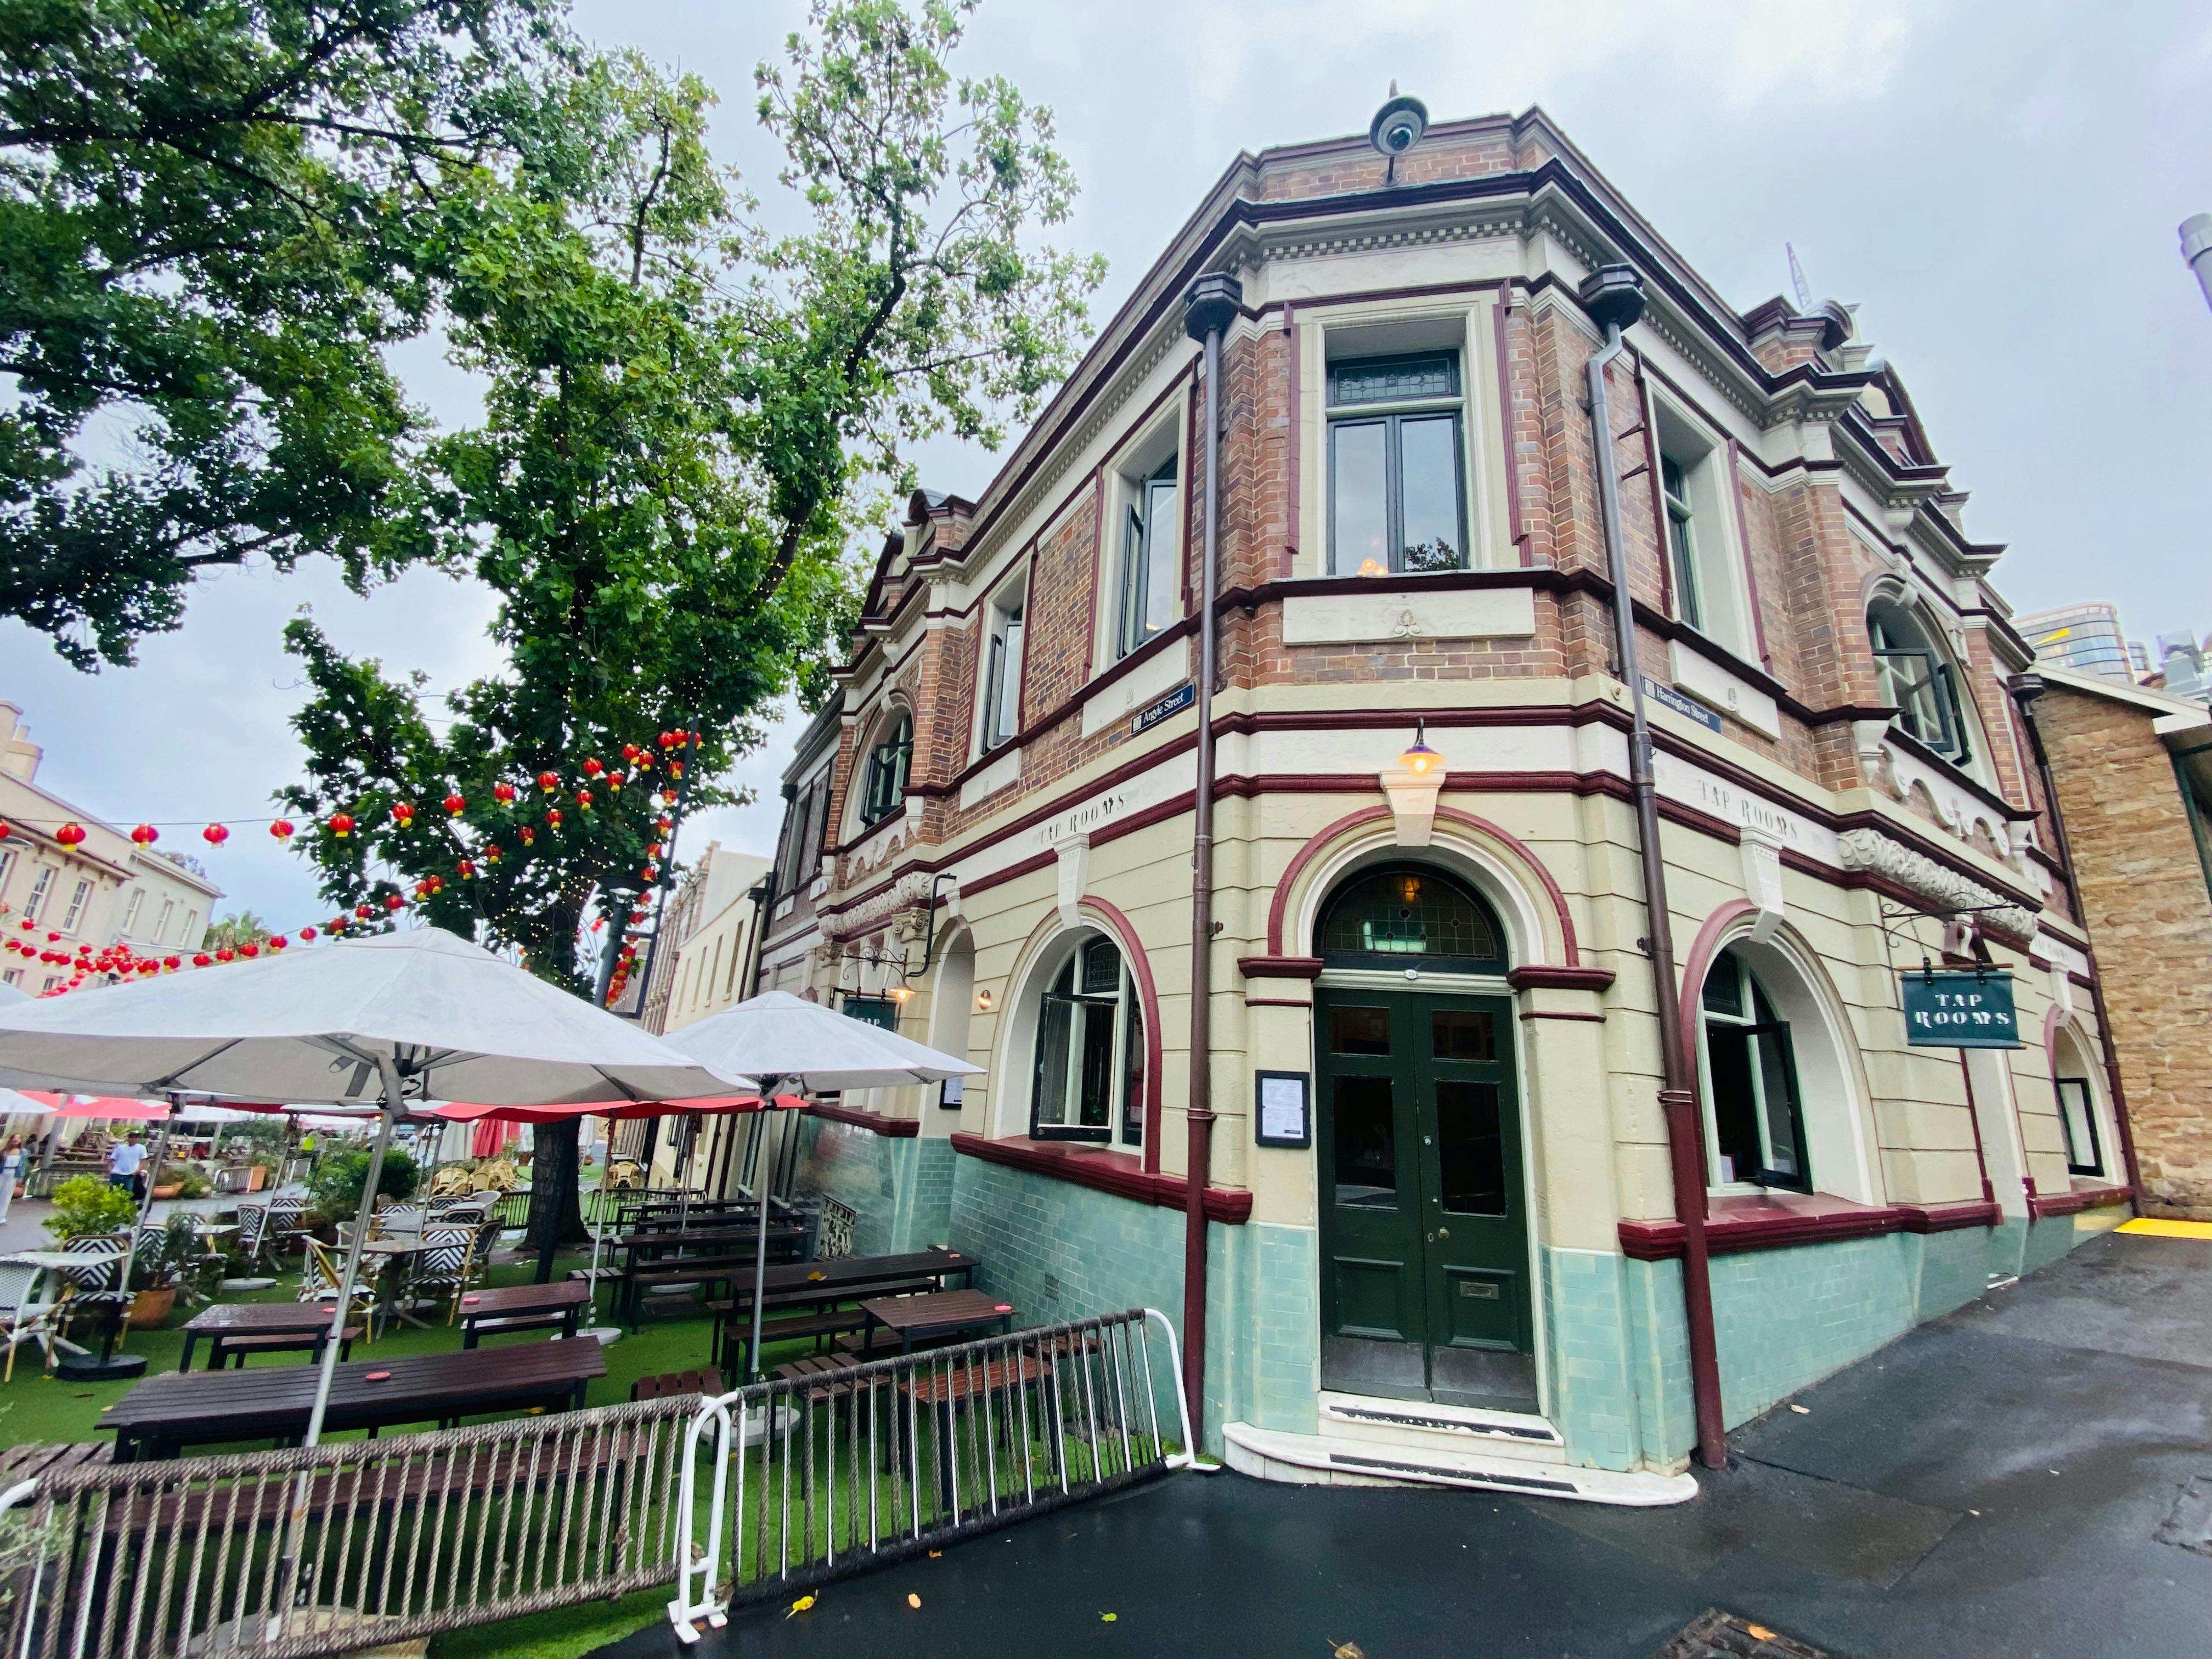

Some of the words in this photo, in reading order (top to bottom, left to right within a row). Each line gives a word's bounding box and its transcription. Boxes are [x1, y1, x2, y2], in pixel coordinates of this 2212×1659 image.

[1143, 704, 1163, 723] Argyle
[1164, 692, 1184, 712] Street
[1657, 686, 1690, 714] Harrington
[1691, 704, 1709, 724] Street
[1040, 823, 1061, 844] TAP
[1070, 793, 1124, 833] ROOMS
[1699, 780, 1730, 809] TAP
[1741, 799, 1797, 839] ROOMS
[1934, 994, 1983, 1007] TAP
[1914, 1011, 2010, 1028] ROOMS
